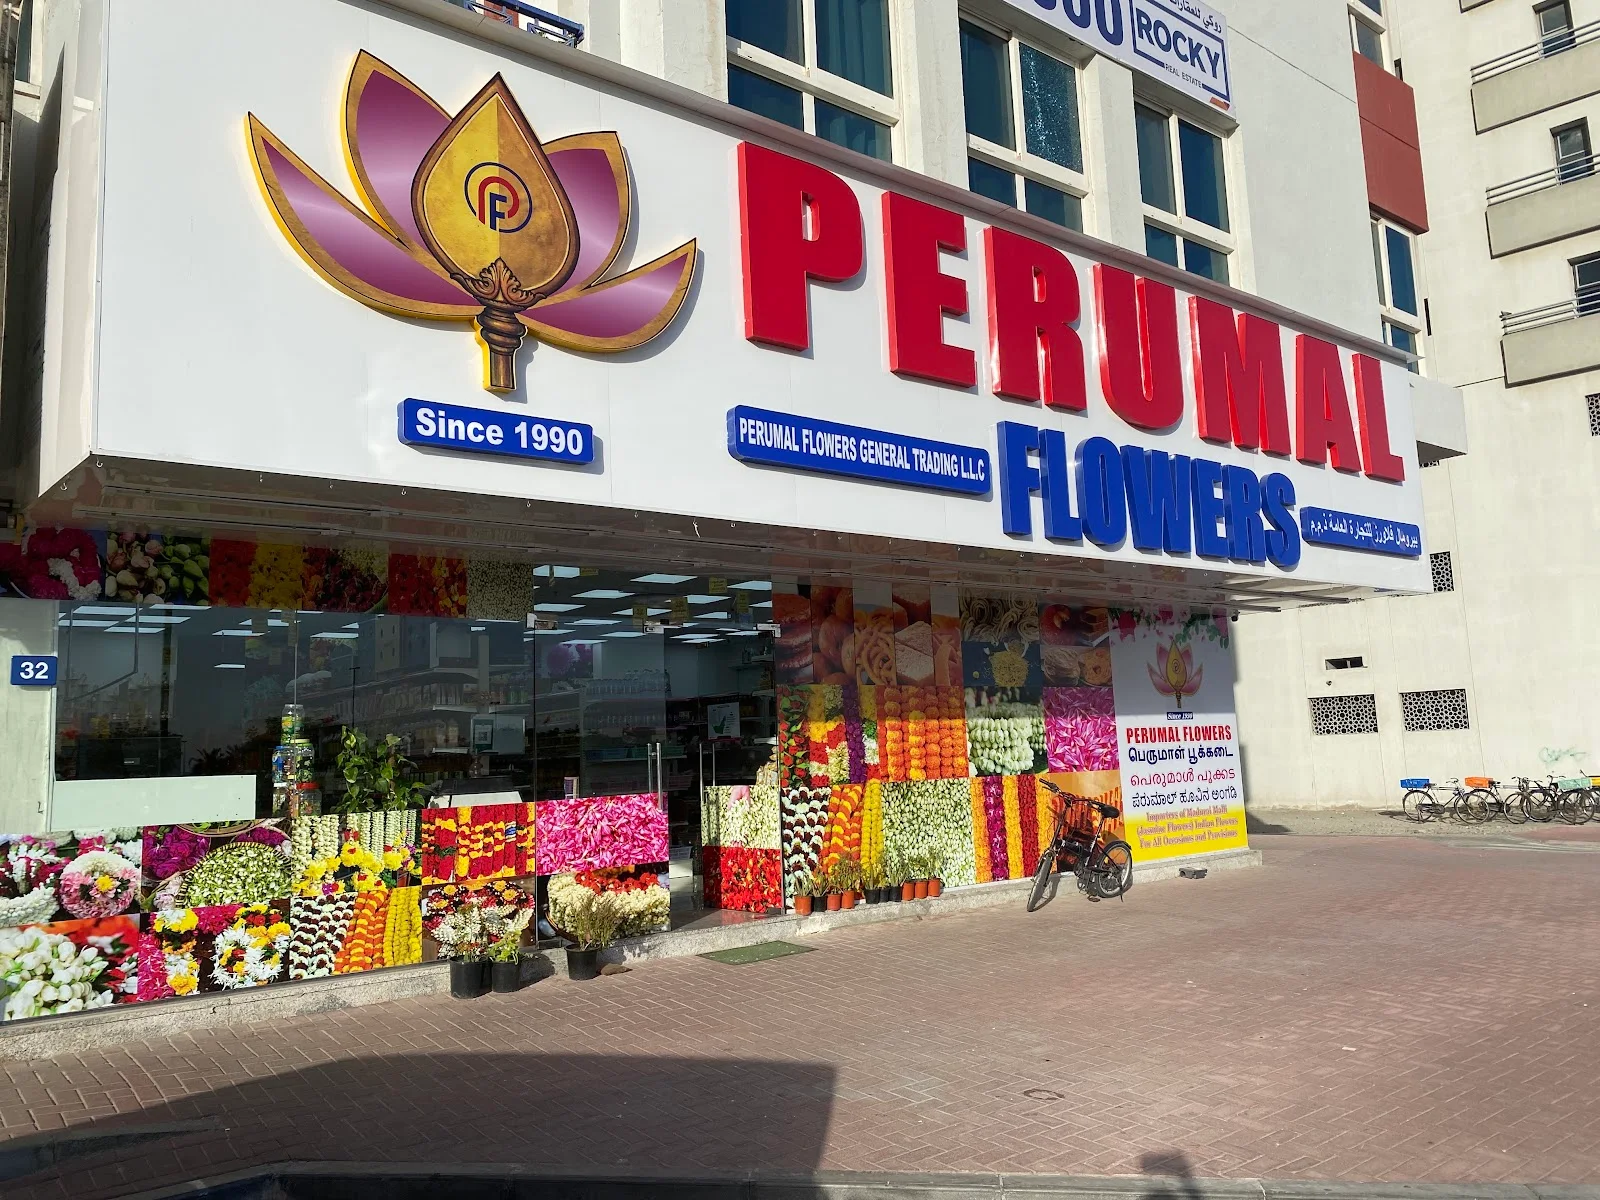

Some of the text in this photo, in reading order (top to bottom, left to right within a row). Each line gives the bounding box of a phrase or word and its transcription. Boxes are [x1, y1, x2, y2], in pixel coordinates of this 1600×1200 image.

[1203, 15, 1222, 33] روكي
[1136, 8, 1220, 79] ROCKY
[1165, 63, 1202, 88] REAL ESTATE
[738, 141, 1405, 482] PERUMAL
[416, 407, 583, 455] Since 1990
[740, 417, 985, 482] PERUMAL FLOWERS GENERAL TRADING L.L.C
[997, 420, 1301, 568] FLOWERS
[20, 661, 49, 680] 32
[1167, 712, 1181, 720] Since
[1126, 724, 1232, 744] PERUMAL FLOWERS
[1128, 744, 1234, 765] பெருமாள் பூக்கடை
[1195, 818, 1215, 829] Indian
[1215, 816, 1238, 828] Flowers
[1140, 838, 1151, 849] For
[1153, 836, 1162, 847] All
[1195, 831, 1207, 842] and
